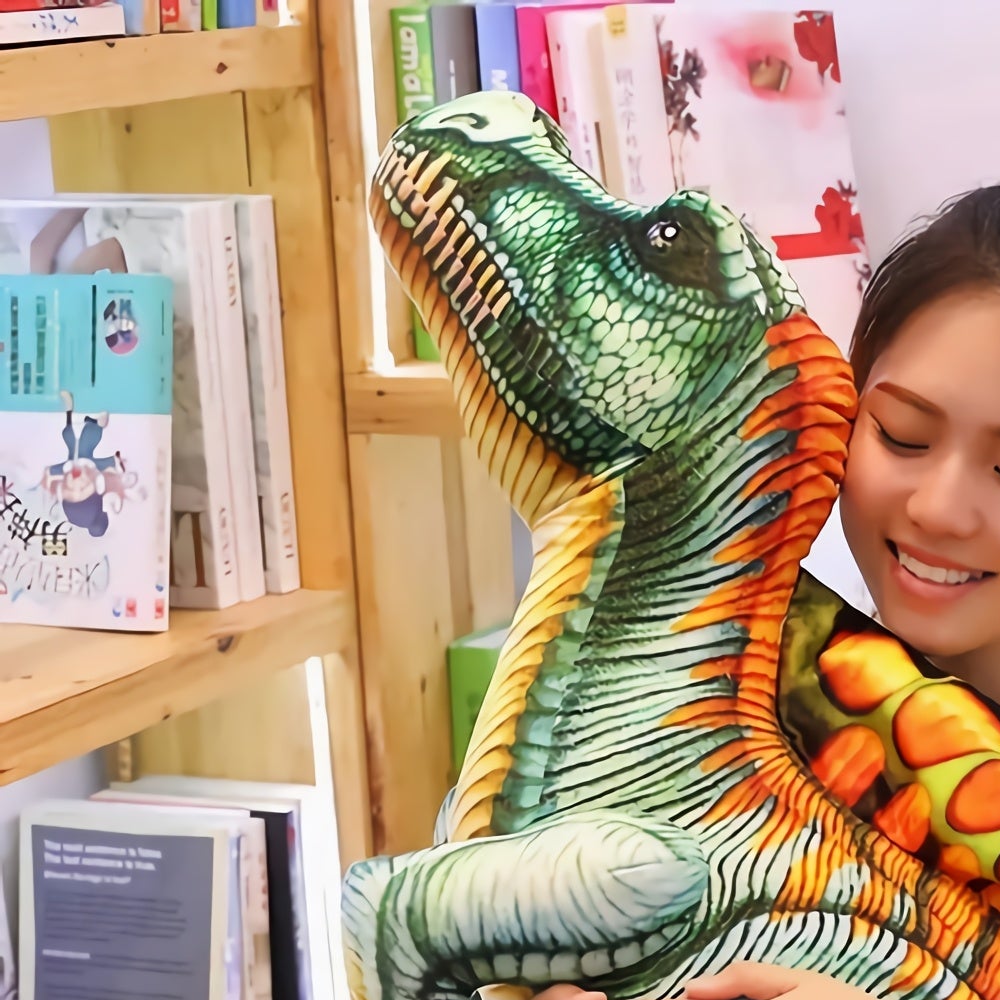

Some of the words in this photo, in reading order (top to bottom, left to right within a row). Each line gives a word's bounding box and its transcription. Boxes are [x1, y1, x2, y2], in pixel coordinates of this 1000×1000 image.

[398, 14, 427, 23] I
[399, 26, 419, 71] am
[402, 73, 421, 92] a
